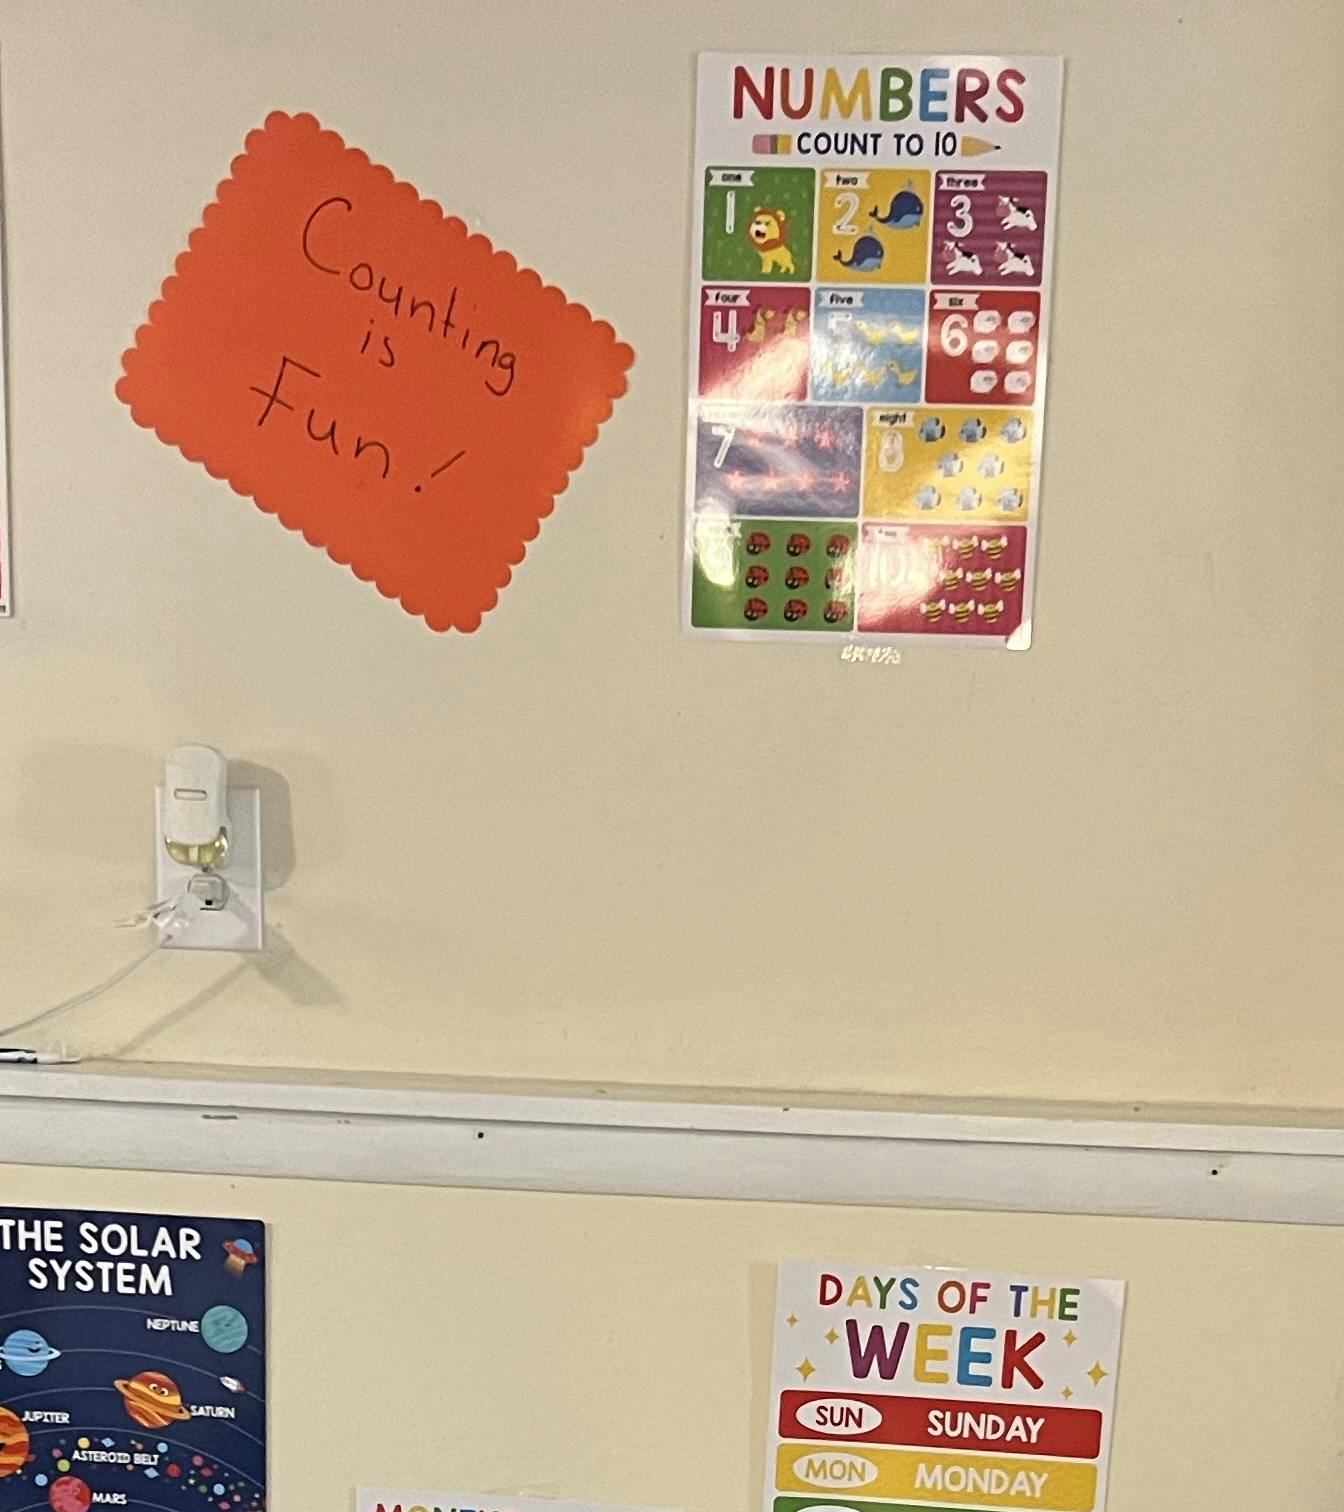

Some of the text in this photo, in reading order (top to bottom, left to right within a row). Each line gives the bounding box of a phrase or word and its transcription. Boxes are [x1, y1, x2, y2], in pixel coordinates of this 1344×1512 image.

[733, 66, 1026, 123] NUMBERS
[797, 132, 957, 157] COUNT TO 10
[832, 192, 860, 235] 2
[946, 195, 973, 237] 3
[303, 196, 516, 397] Counting
[829, 294, 854, 305] five
[361, 318, 395, 368] is
[712, 309, 968, 357] 4 6
[249, 355, 466, 493] Fun!
[711, 425, 736, 468] 7
[79, 1222, 202, 1260] SOLAR
[27, 1258, 173, 1296] SYSTEM
[819, 1274, 1080, 1321] DAYS OF THE
[146, 1318, 200, 1333] NEPTUNE
[846, 1319, 1046, 1390] WEEK
[21, 1411, 70, 1424] JUPITER
[189, 1405, 236, 1419] SATURN
[815, 1405, 1045, 1443] SUN SUNDAY
[72, 1451, 160, 1465] ASTEROID BELT
[805, 1459, 1048, 1497] MON MONDAY
[91, 1492, 127, 1505] MARS
